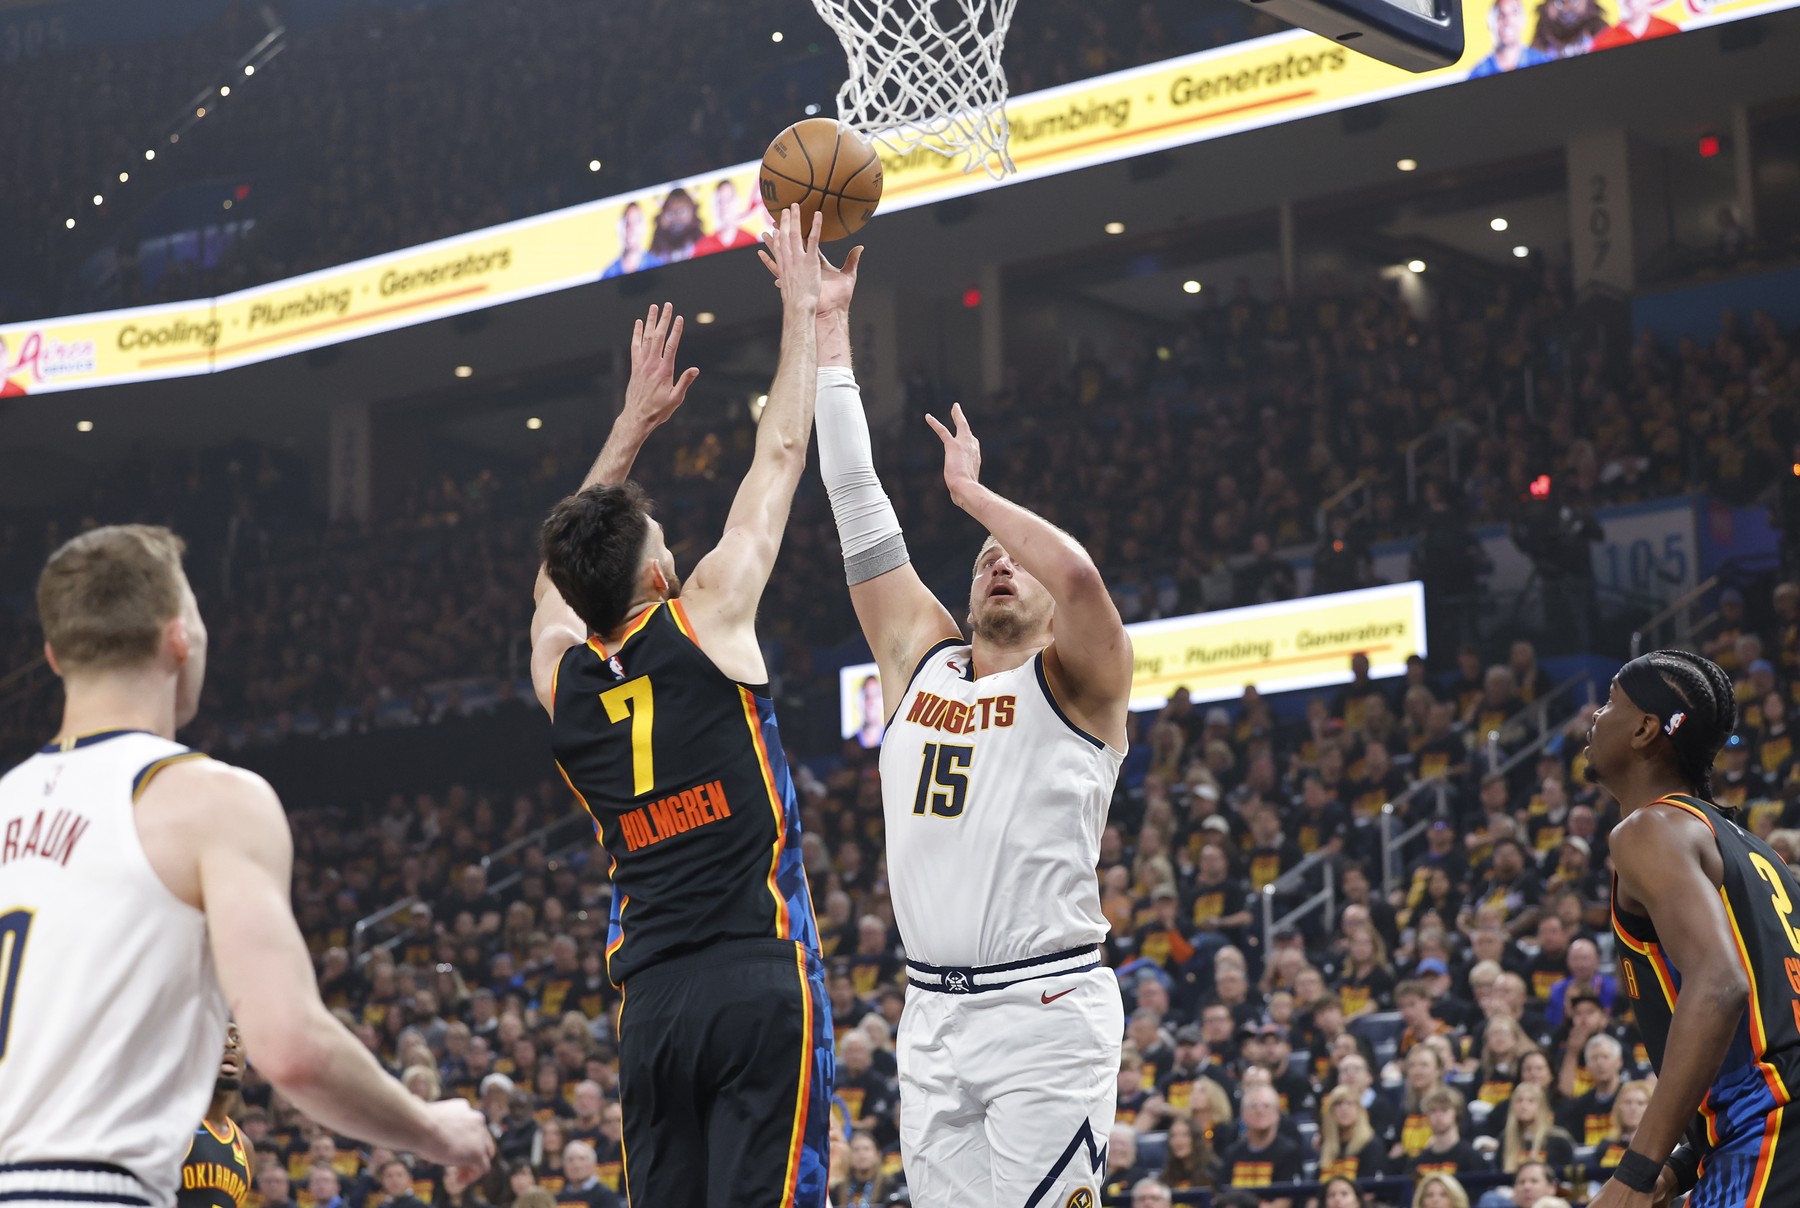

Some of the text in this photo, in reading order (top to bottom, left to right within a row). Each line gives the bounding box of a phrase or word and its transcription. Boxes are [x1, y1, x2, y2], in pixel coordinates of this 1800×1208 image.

[1169, 47, 1346, 106] Generators
[1587, 172, 1612, 273] 207
[117, 247, 513, 351] Cooling Plumbing Generators
[1605, 532, 1687, 590] 105
[1184, 639, 1274, 665] Plumbing
[1296, 621, 1406, 650] Generators
[598, 674, 655, 797] 7
[905, 690, 1018, 736] NUGETS
[618, 779, 733, 853] HOLMGREN
[911, 740, 976, 820] 15
[1748, 851, 1800, 956] 2
